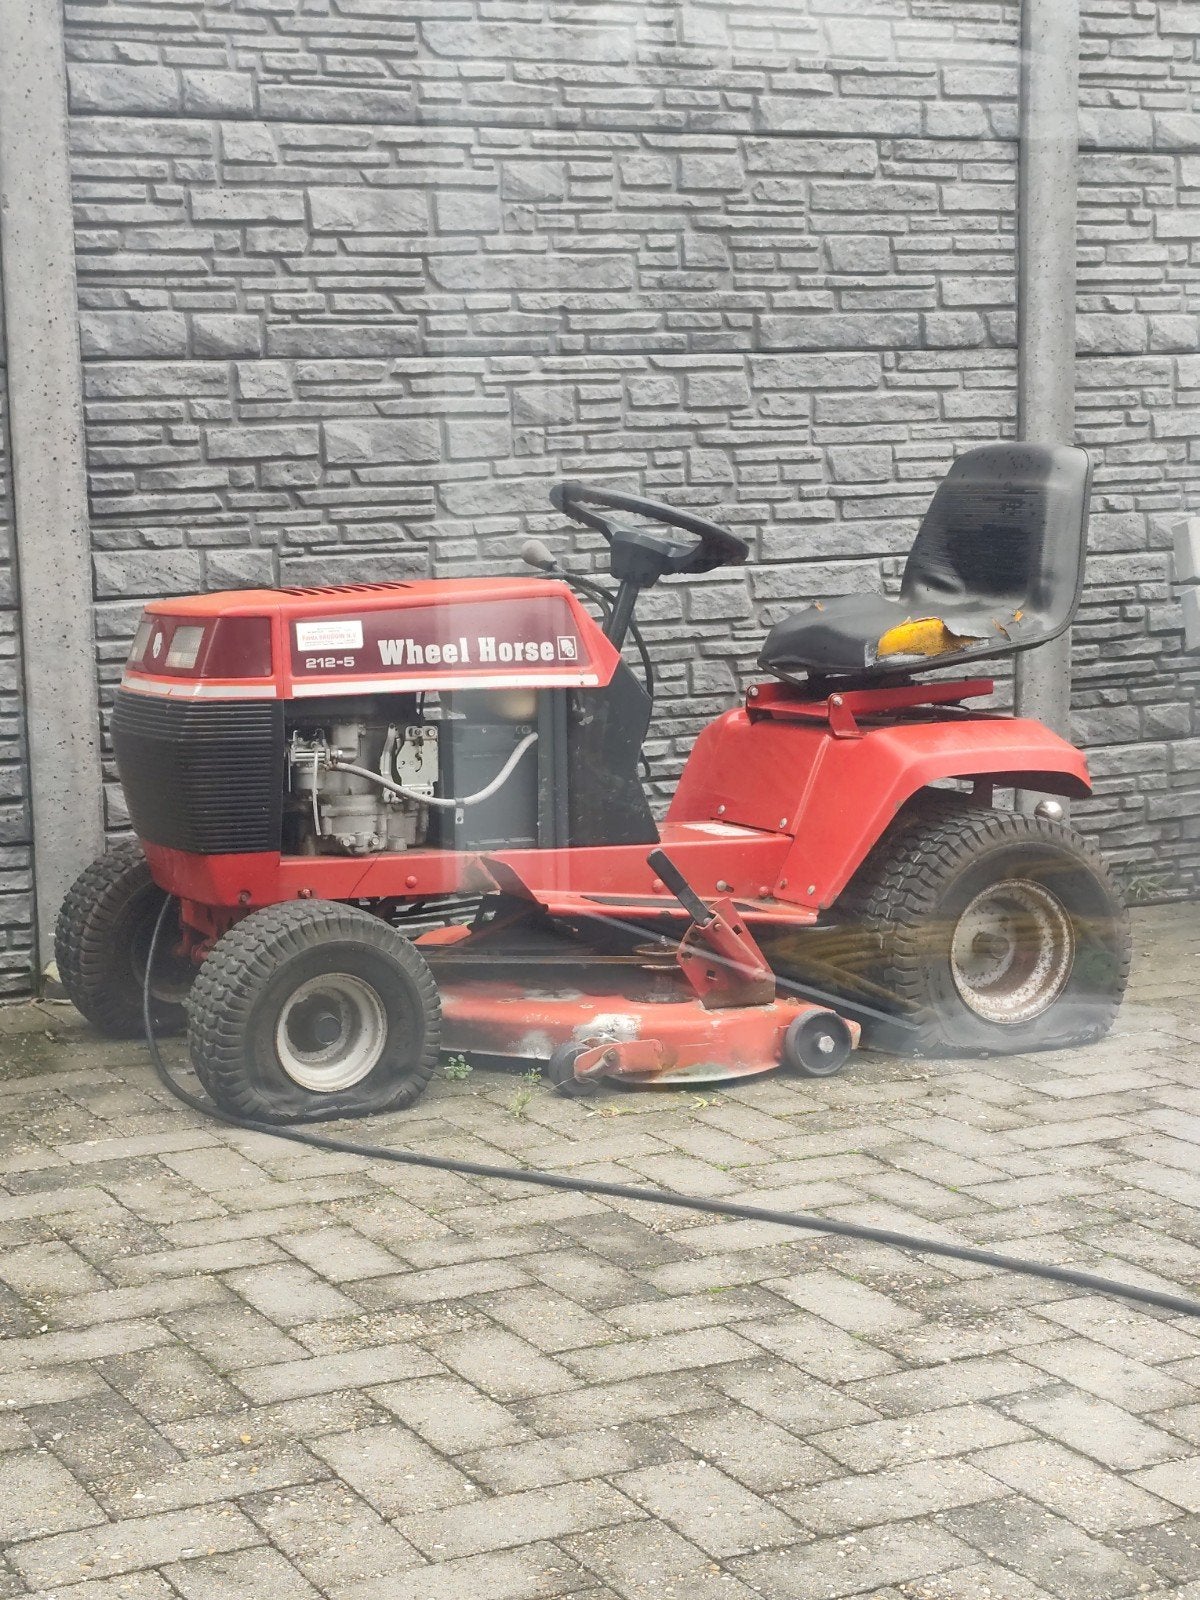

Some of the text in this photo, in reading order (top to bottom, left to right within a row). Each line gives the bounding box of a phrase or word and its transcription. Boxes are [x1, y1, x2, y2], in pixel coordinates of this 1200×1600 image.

[377, 636, 555, 666] Wheel Horse
[305, 656, 355, 669] 212-5
